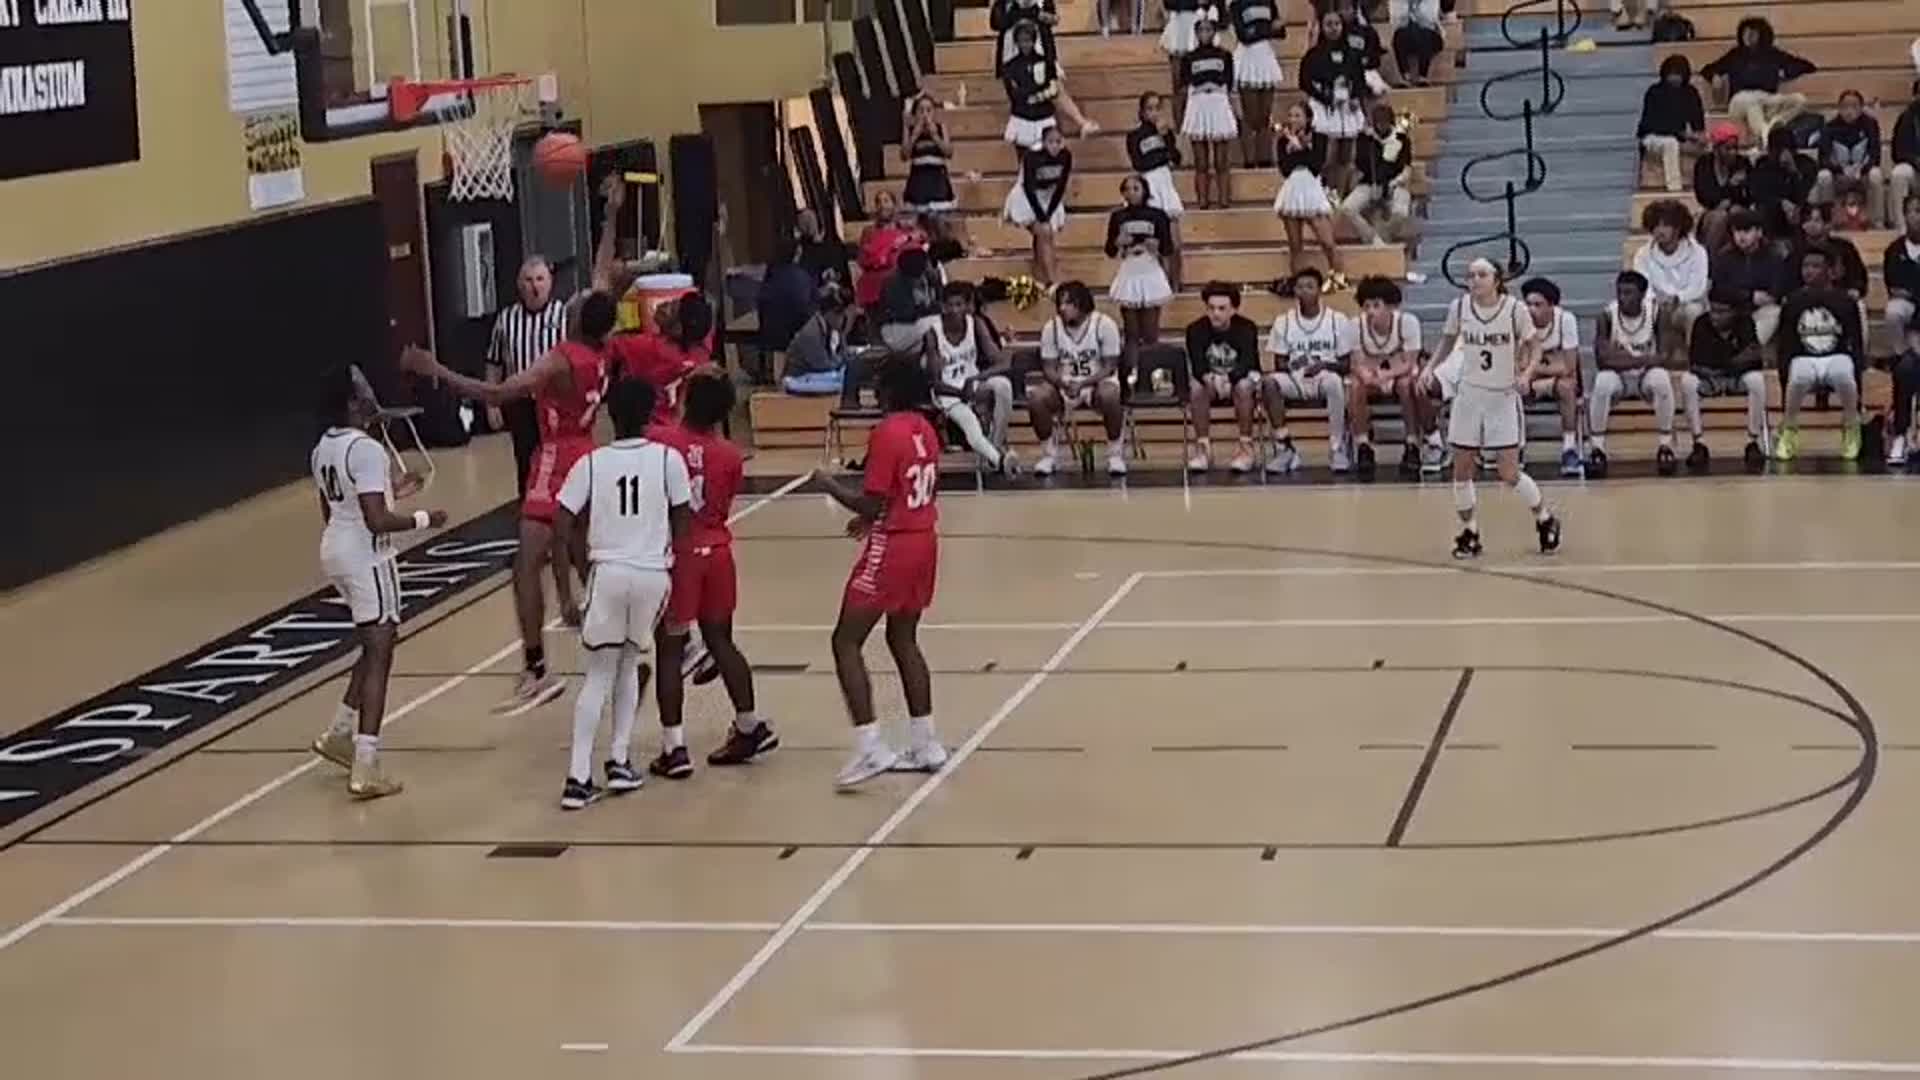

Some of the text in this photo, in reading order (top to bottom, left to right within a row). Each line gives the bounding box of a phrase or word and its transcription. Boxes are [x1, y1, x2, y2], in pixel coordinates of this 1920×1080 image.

[1070, 360, 1091, 377] 35
[1480, 350, 1492, 371] 3
[321, 464, 345, 502] 10
[616, 475, 639, 516] 11
[906, 463, 936, 509] 30
